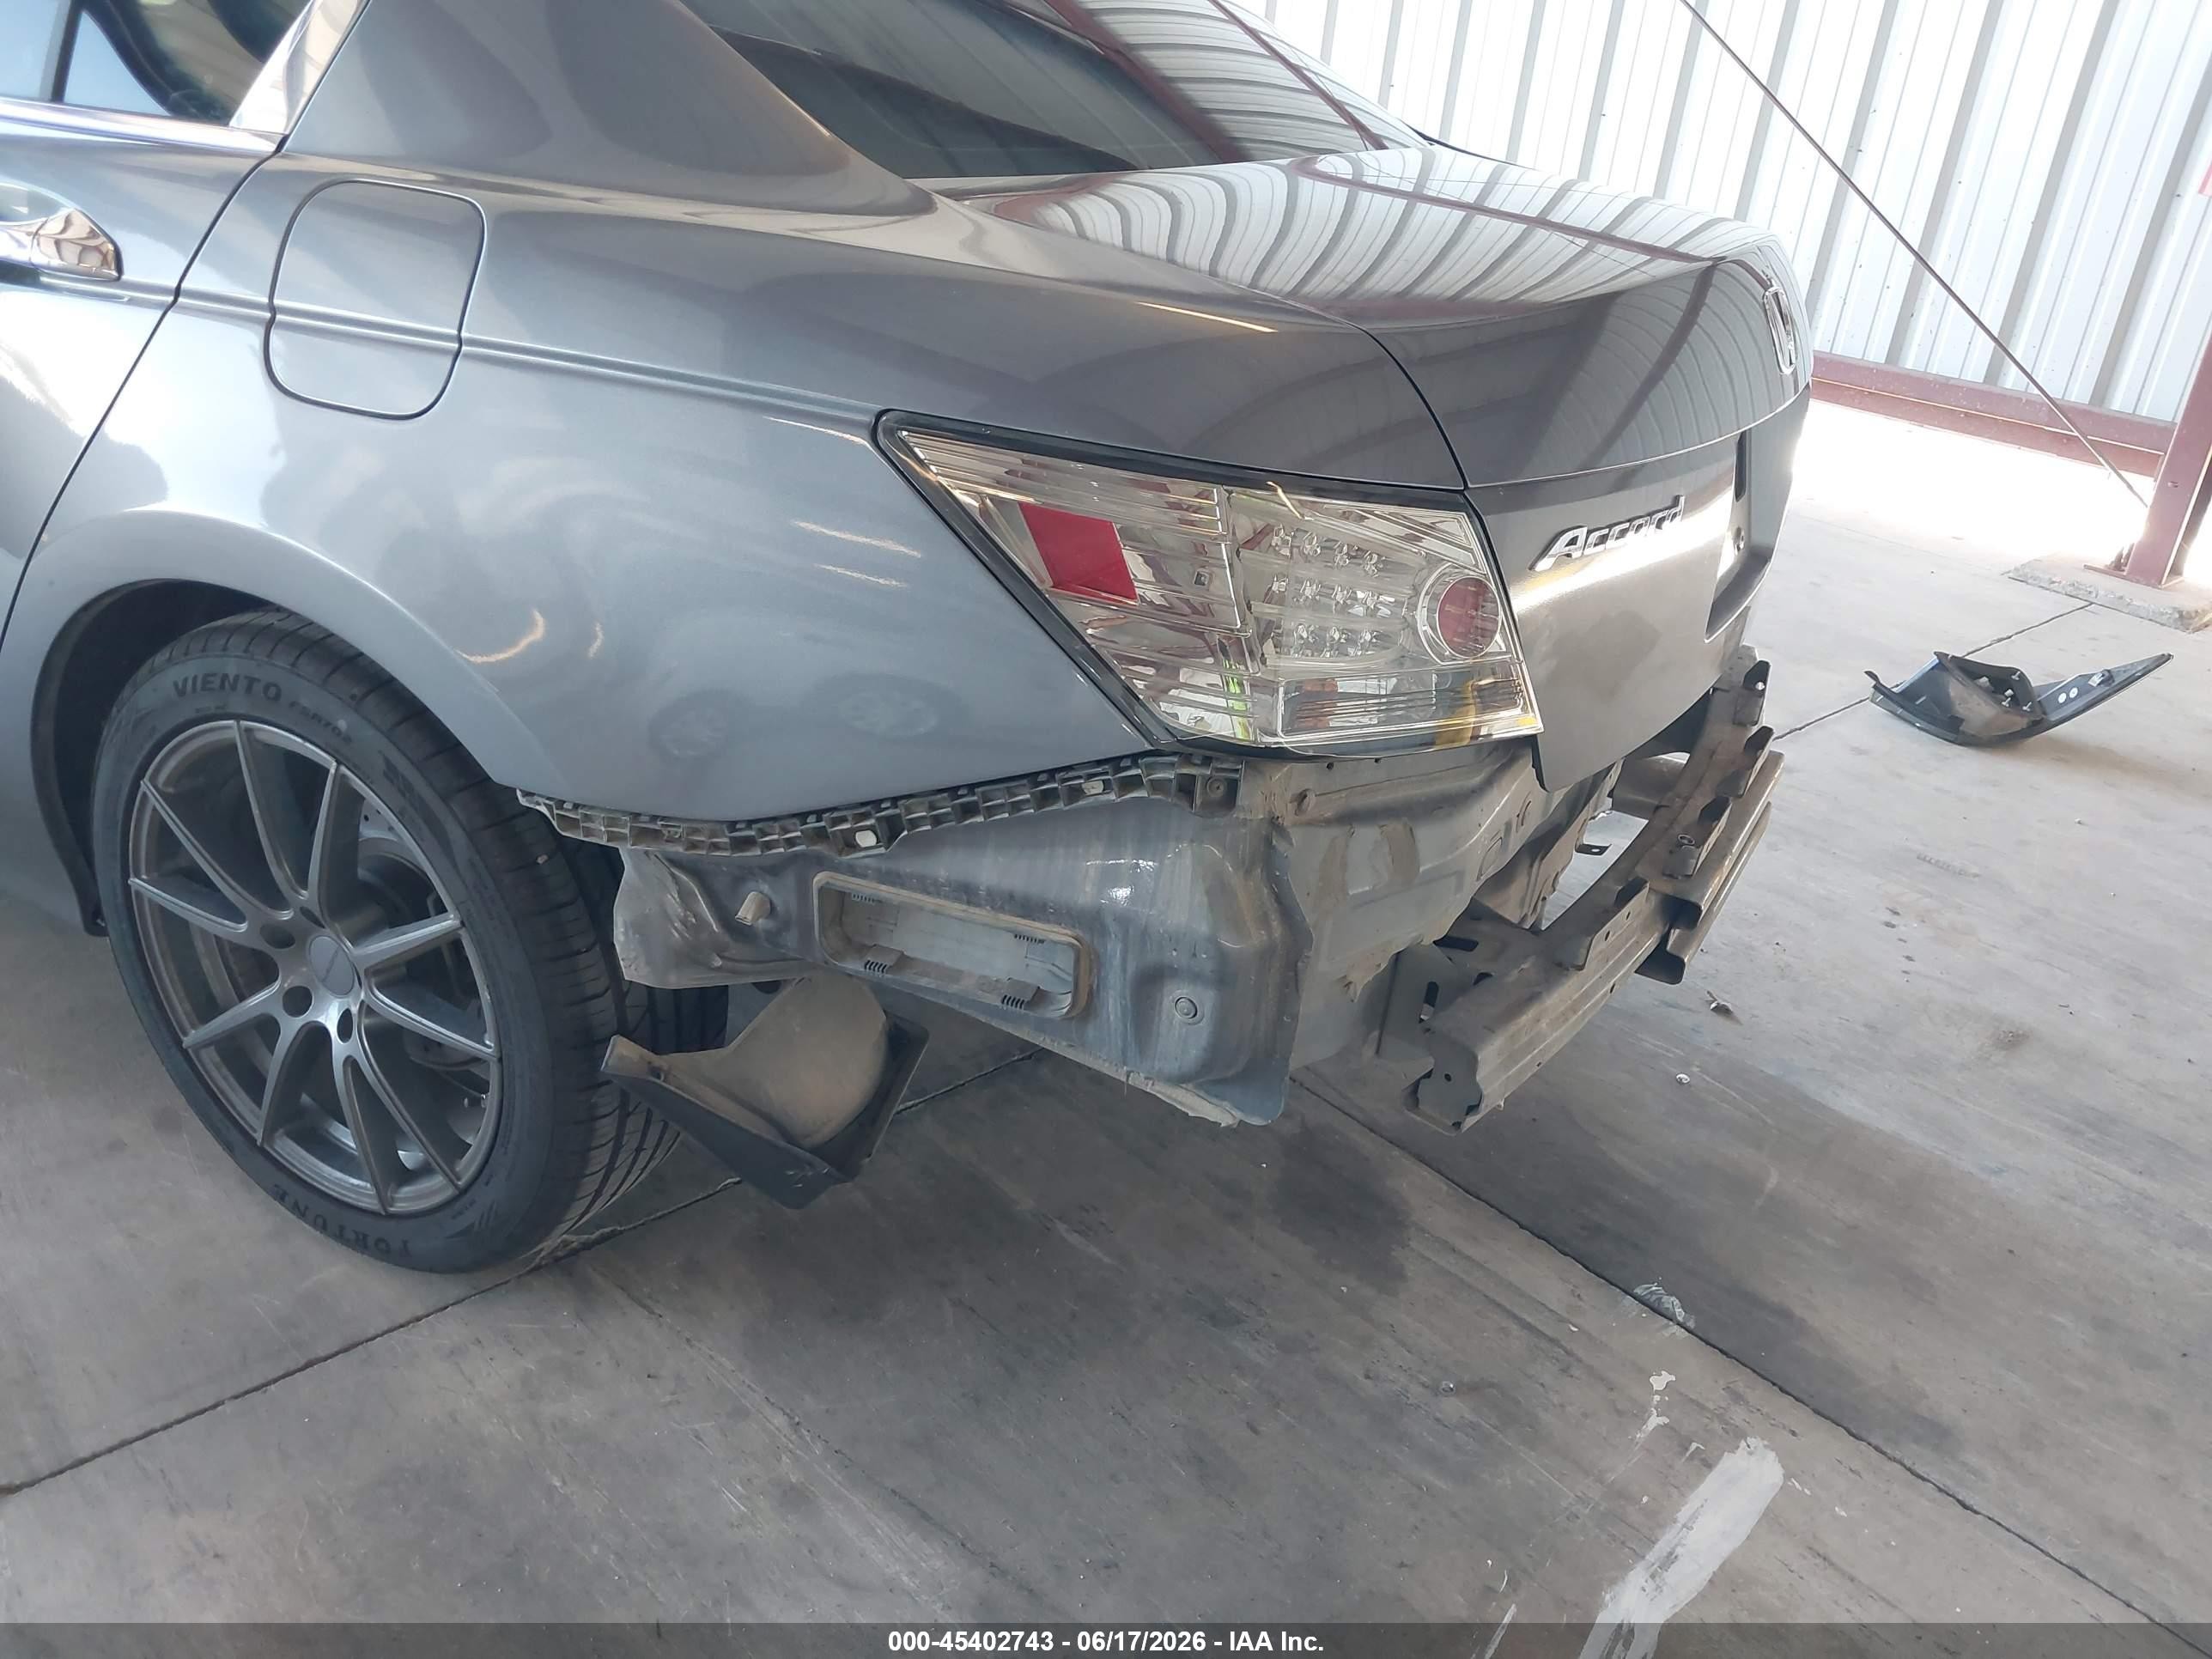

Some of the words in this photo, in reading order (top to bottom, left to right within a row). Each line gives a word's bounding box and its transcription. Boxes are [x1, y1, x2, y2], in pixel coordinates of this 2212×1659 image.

[1528, 495, 1685, 571] Accord
[173, 672, 282, 702] VIENTO
[271, 1183, 412, 1258] FORTUNE
